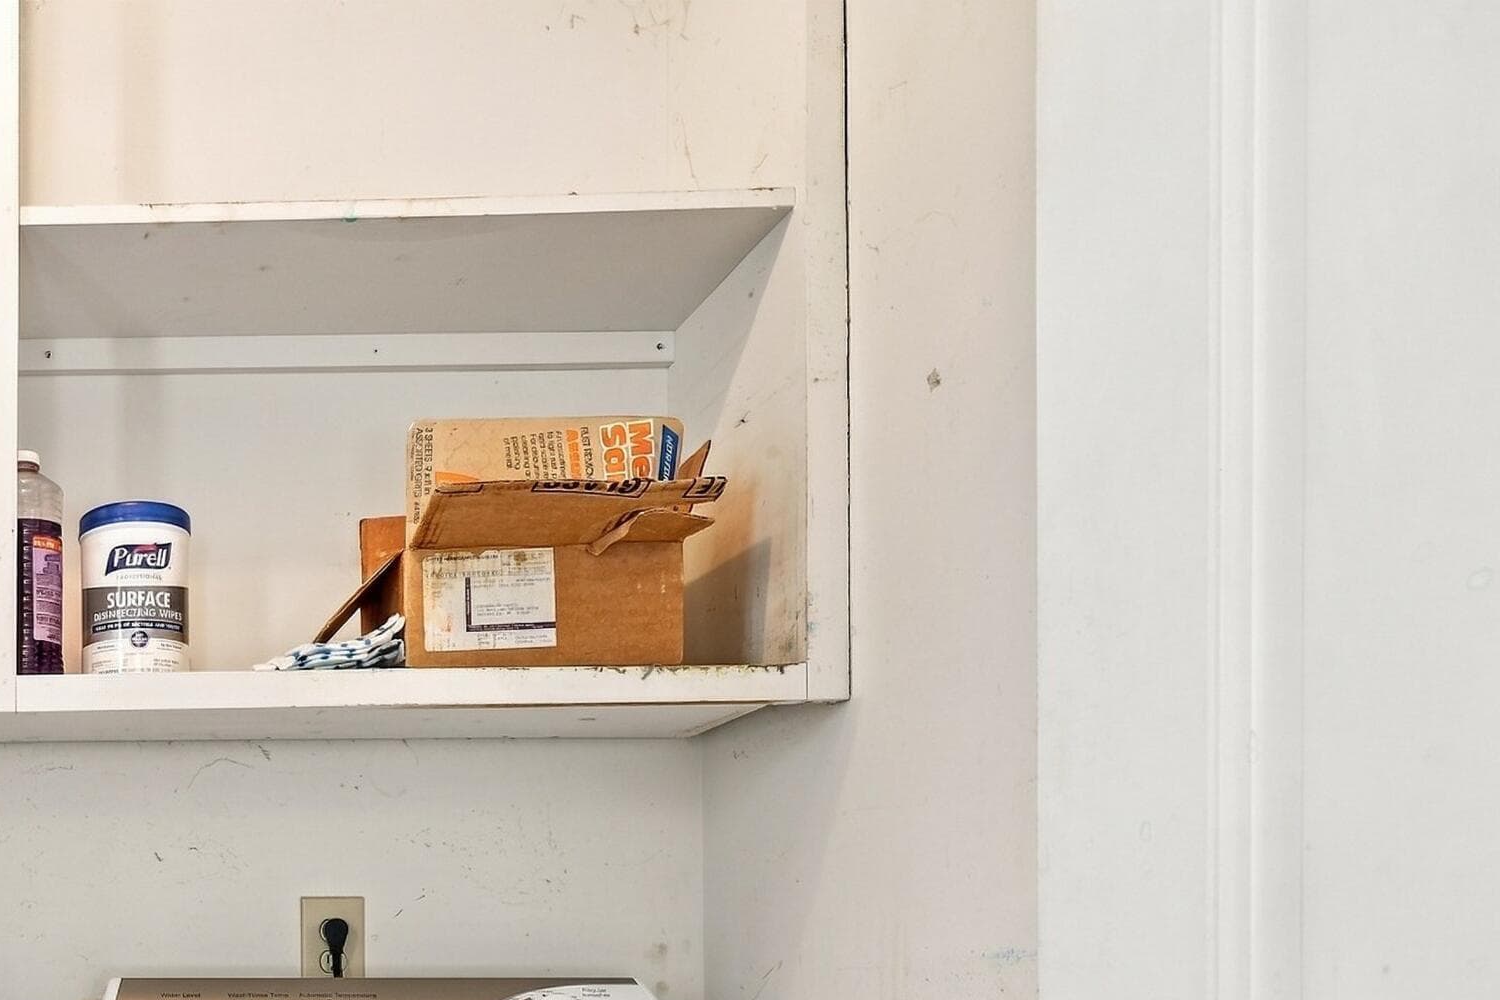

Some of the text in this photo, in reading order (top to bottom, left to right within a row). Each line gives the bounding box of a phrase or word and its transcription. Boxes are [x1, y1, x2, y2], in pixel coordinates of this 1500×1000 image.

[580, 427, 591, 447] RUST
[415, 428, 424, 472] ASSORTED
[424, 434, 433, 462] SHEETS
[113, 547, 168, 568] Purell
[106, 590, 171, 609] SURFACE
[93, 608, 182, 622] DISINFECTING WIPES
